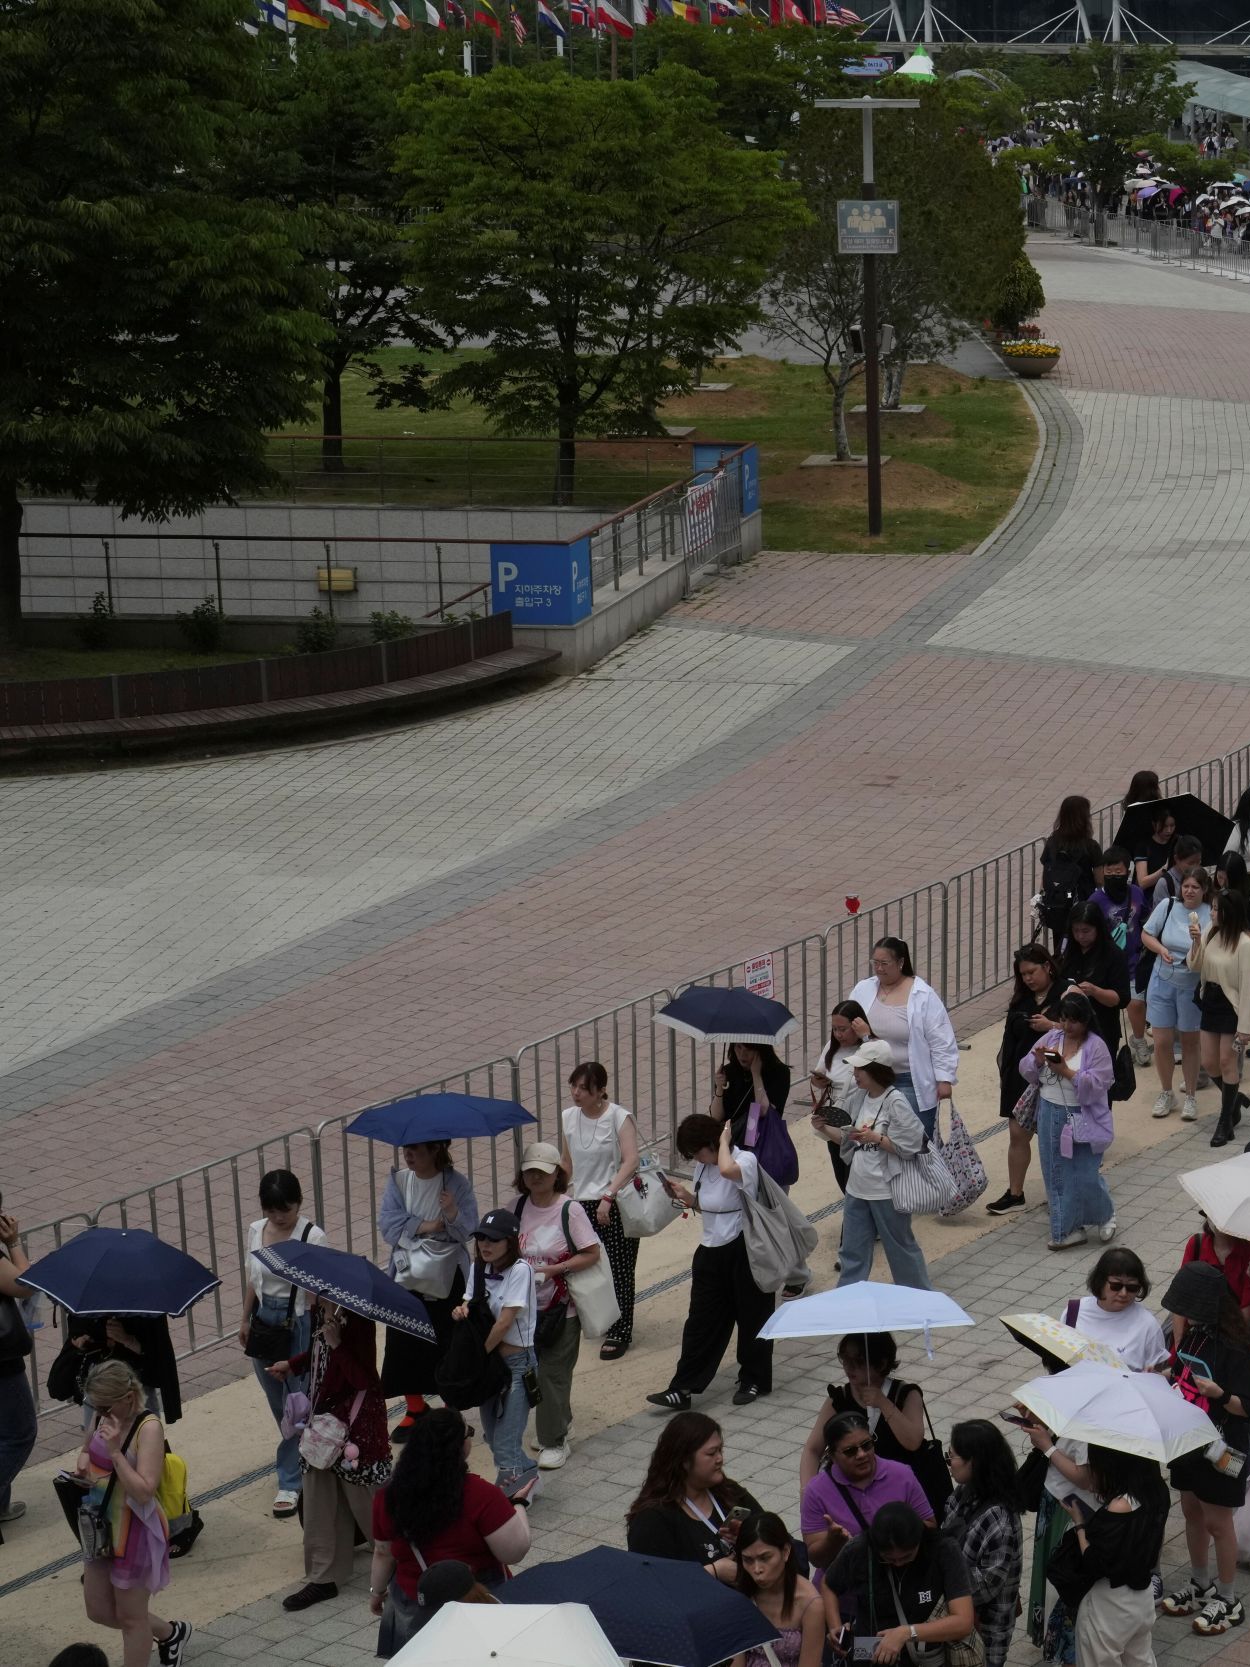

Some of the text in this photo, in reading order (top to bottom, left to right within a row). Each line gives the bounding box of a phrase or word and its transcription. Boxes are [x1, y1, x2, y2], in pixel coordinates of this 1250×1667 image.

[497, 561, 519, 593] P
[571, 560, 579, 593] P
[514, 584, 562, 596] 지하주차장
[514, 597, 552, 607] 출입구 3
